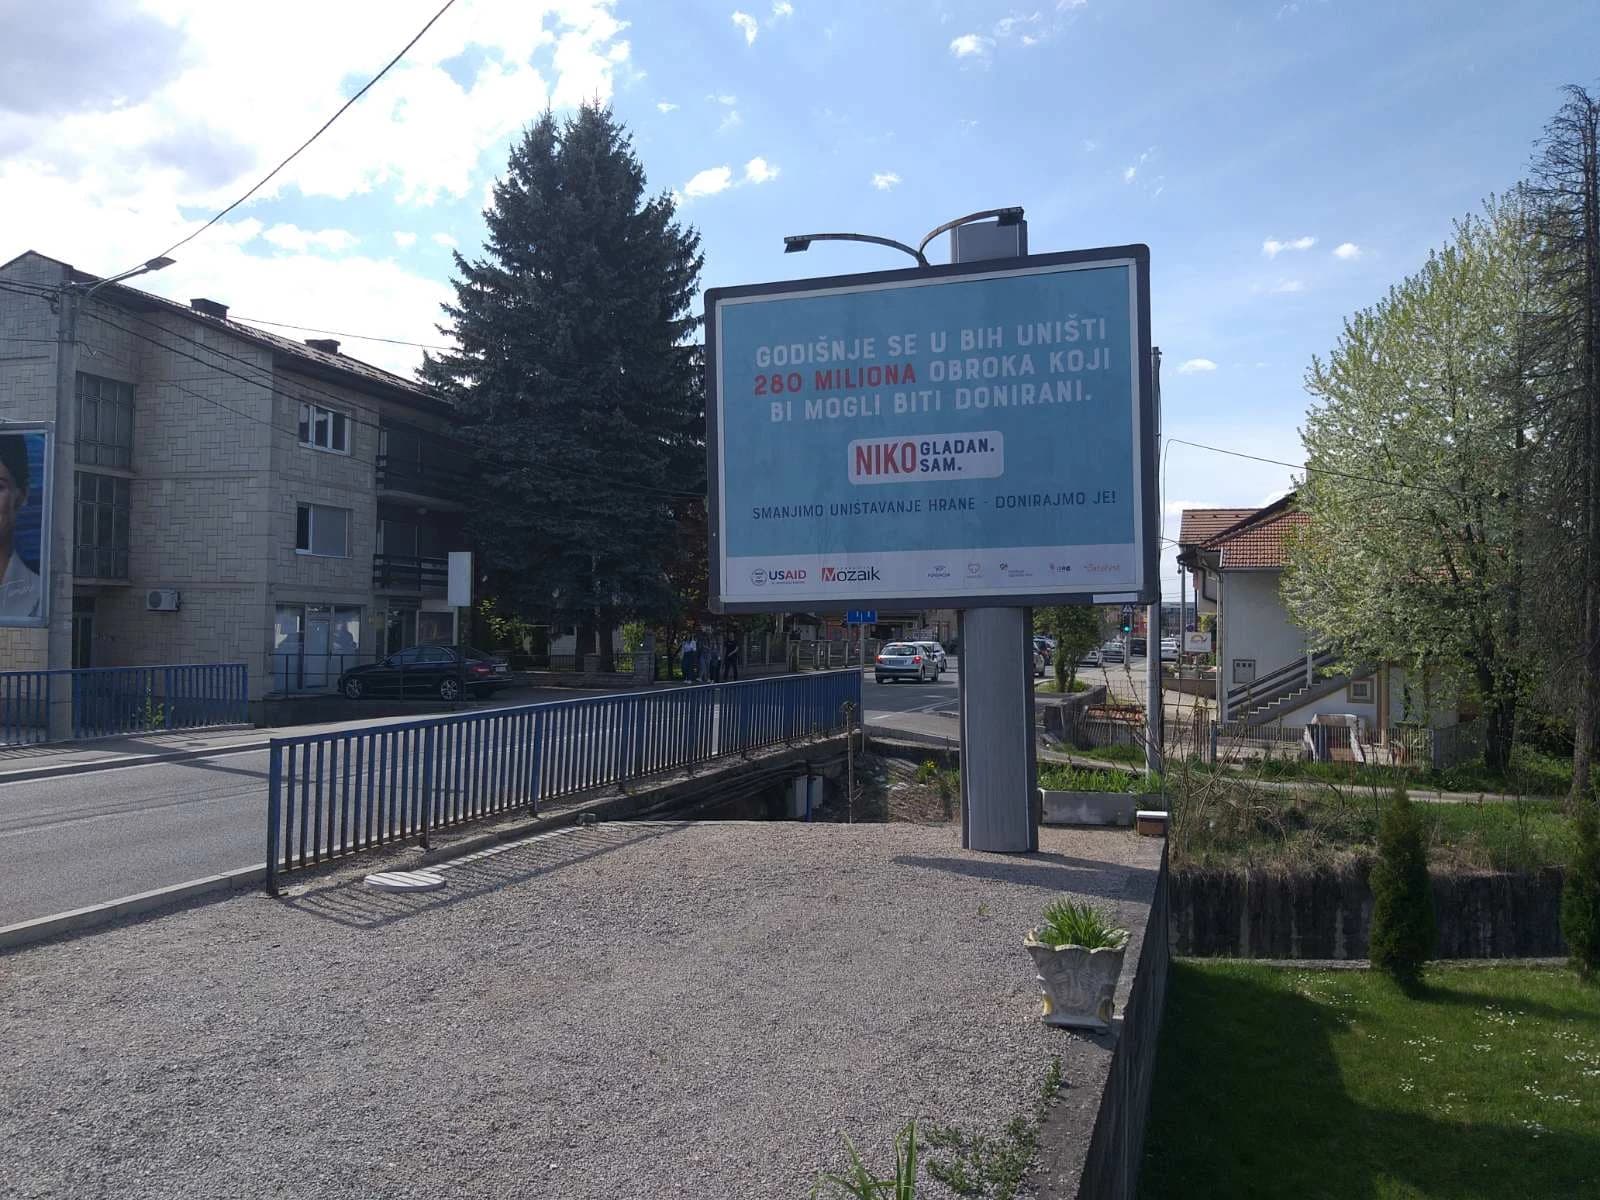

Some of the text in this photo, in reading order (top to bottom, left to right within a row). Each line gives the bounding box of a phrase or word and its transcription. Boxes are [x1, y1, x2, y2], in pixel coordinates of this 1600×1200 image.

[756, 313, 1106, 368] GODIŠNJE SE U BIH UNIŠTI
[754, 347, 1110, 396] 280 MILIONA OBROKA KOJI
[770, 380, 1092, 422] BI MOGLI BITI DONIRANI.
[856, 442, 917, 476] NIKO
[920, 438, 995, 456] GLADAN.
[920, 457, 963, 472] SAM.
[752, 504, 824, 519] SMANJIMO
[928, 497, 975, 512] HRANE
[995, 491, 1086, 509] DONIRAJMO
[1093, 490, 1116, 504] JE!
[768, 570, 807, 580] USAID
